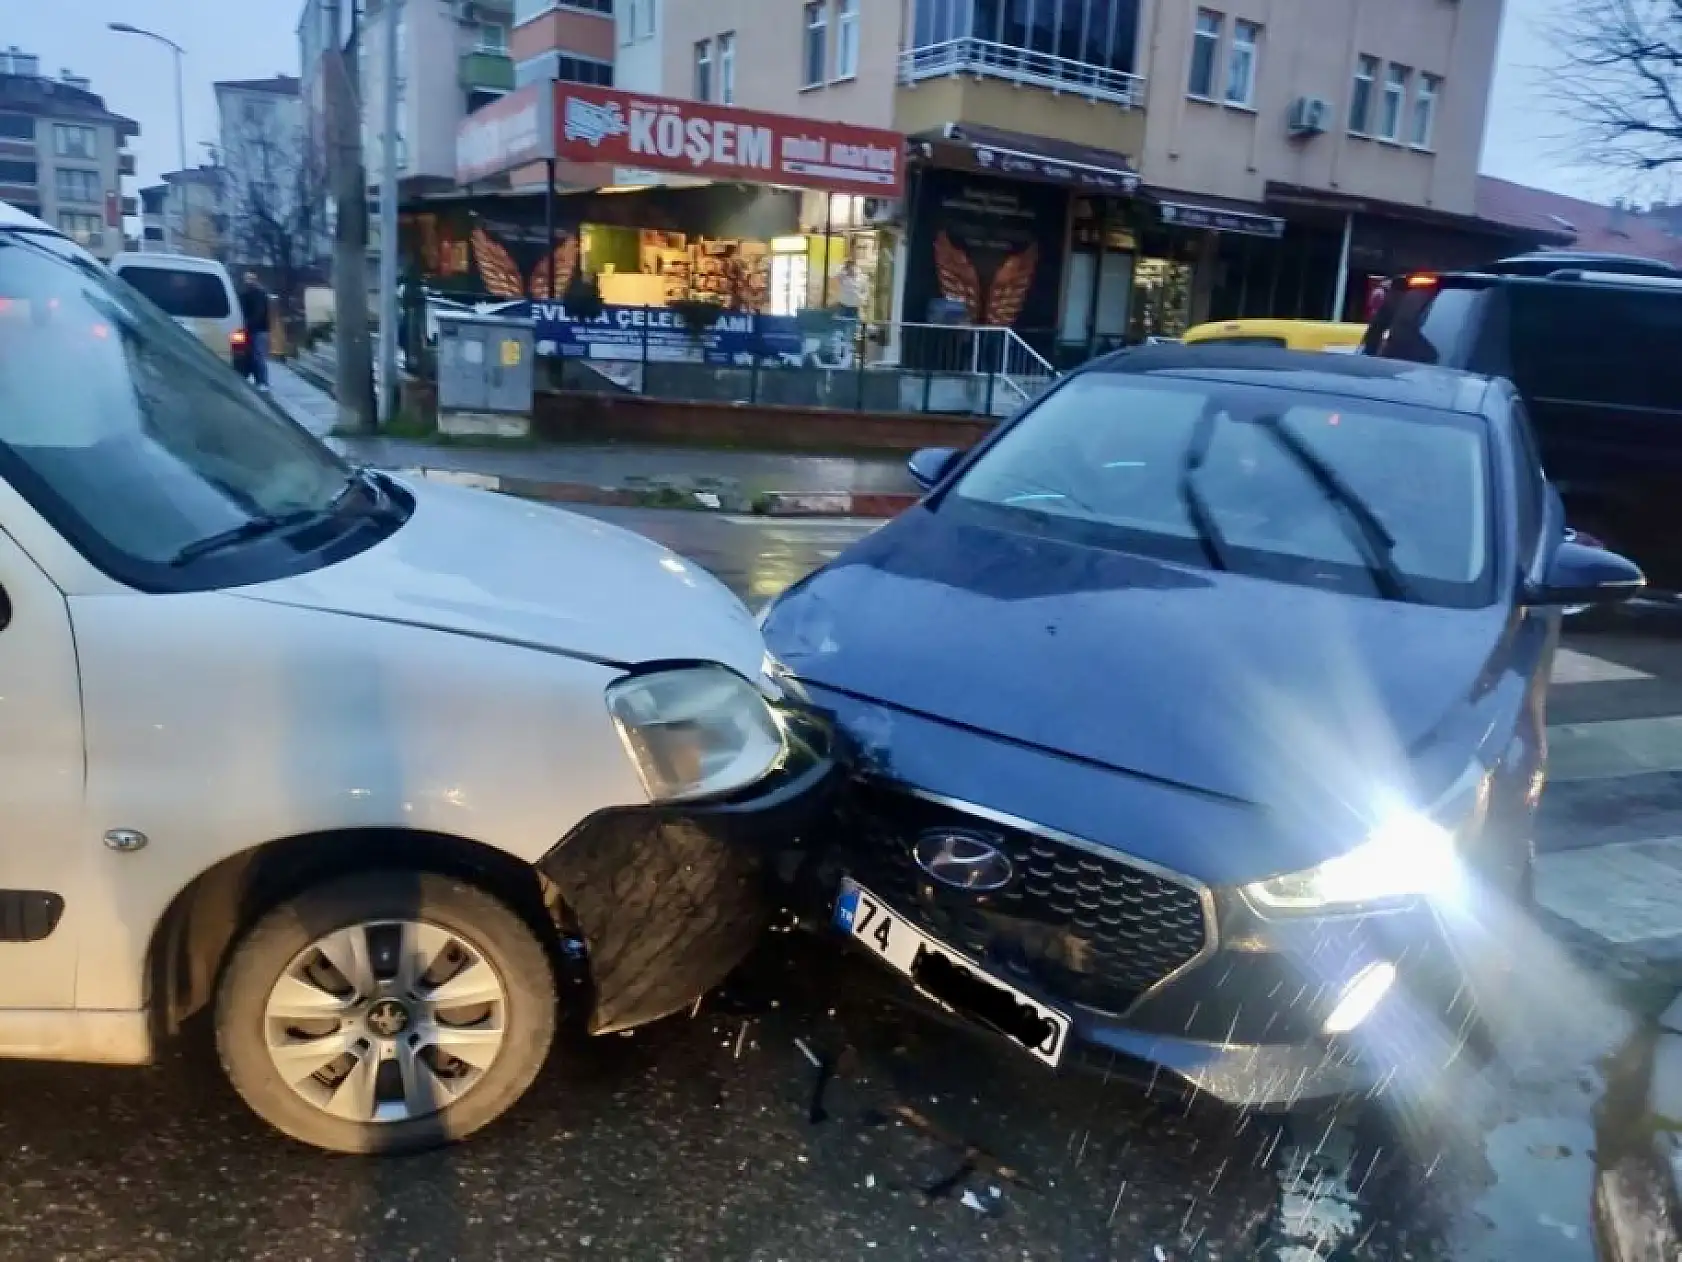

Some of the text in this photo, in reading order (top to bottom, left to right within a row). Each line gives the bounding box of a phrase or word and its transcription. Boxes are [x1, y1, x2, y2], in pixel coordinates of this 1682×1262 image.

[629, 104, 772, 169] KÖŞEM
[531, 303, 612, 324] EVLA
[615, 310, 692, 329] ÇELEB
[856, 897, 892, 952] 74
